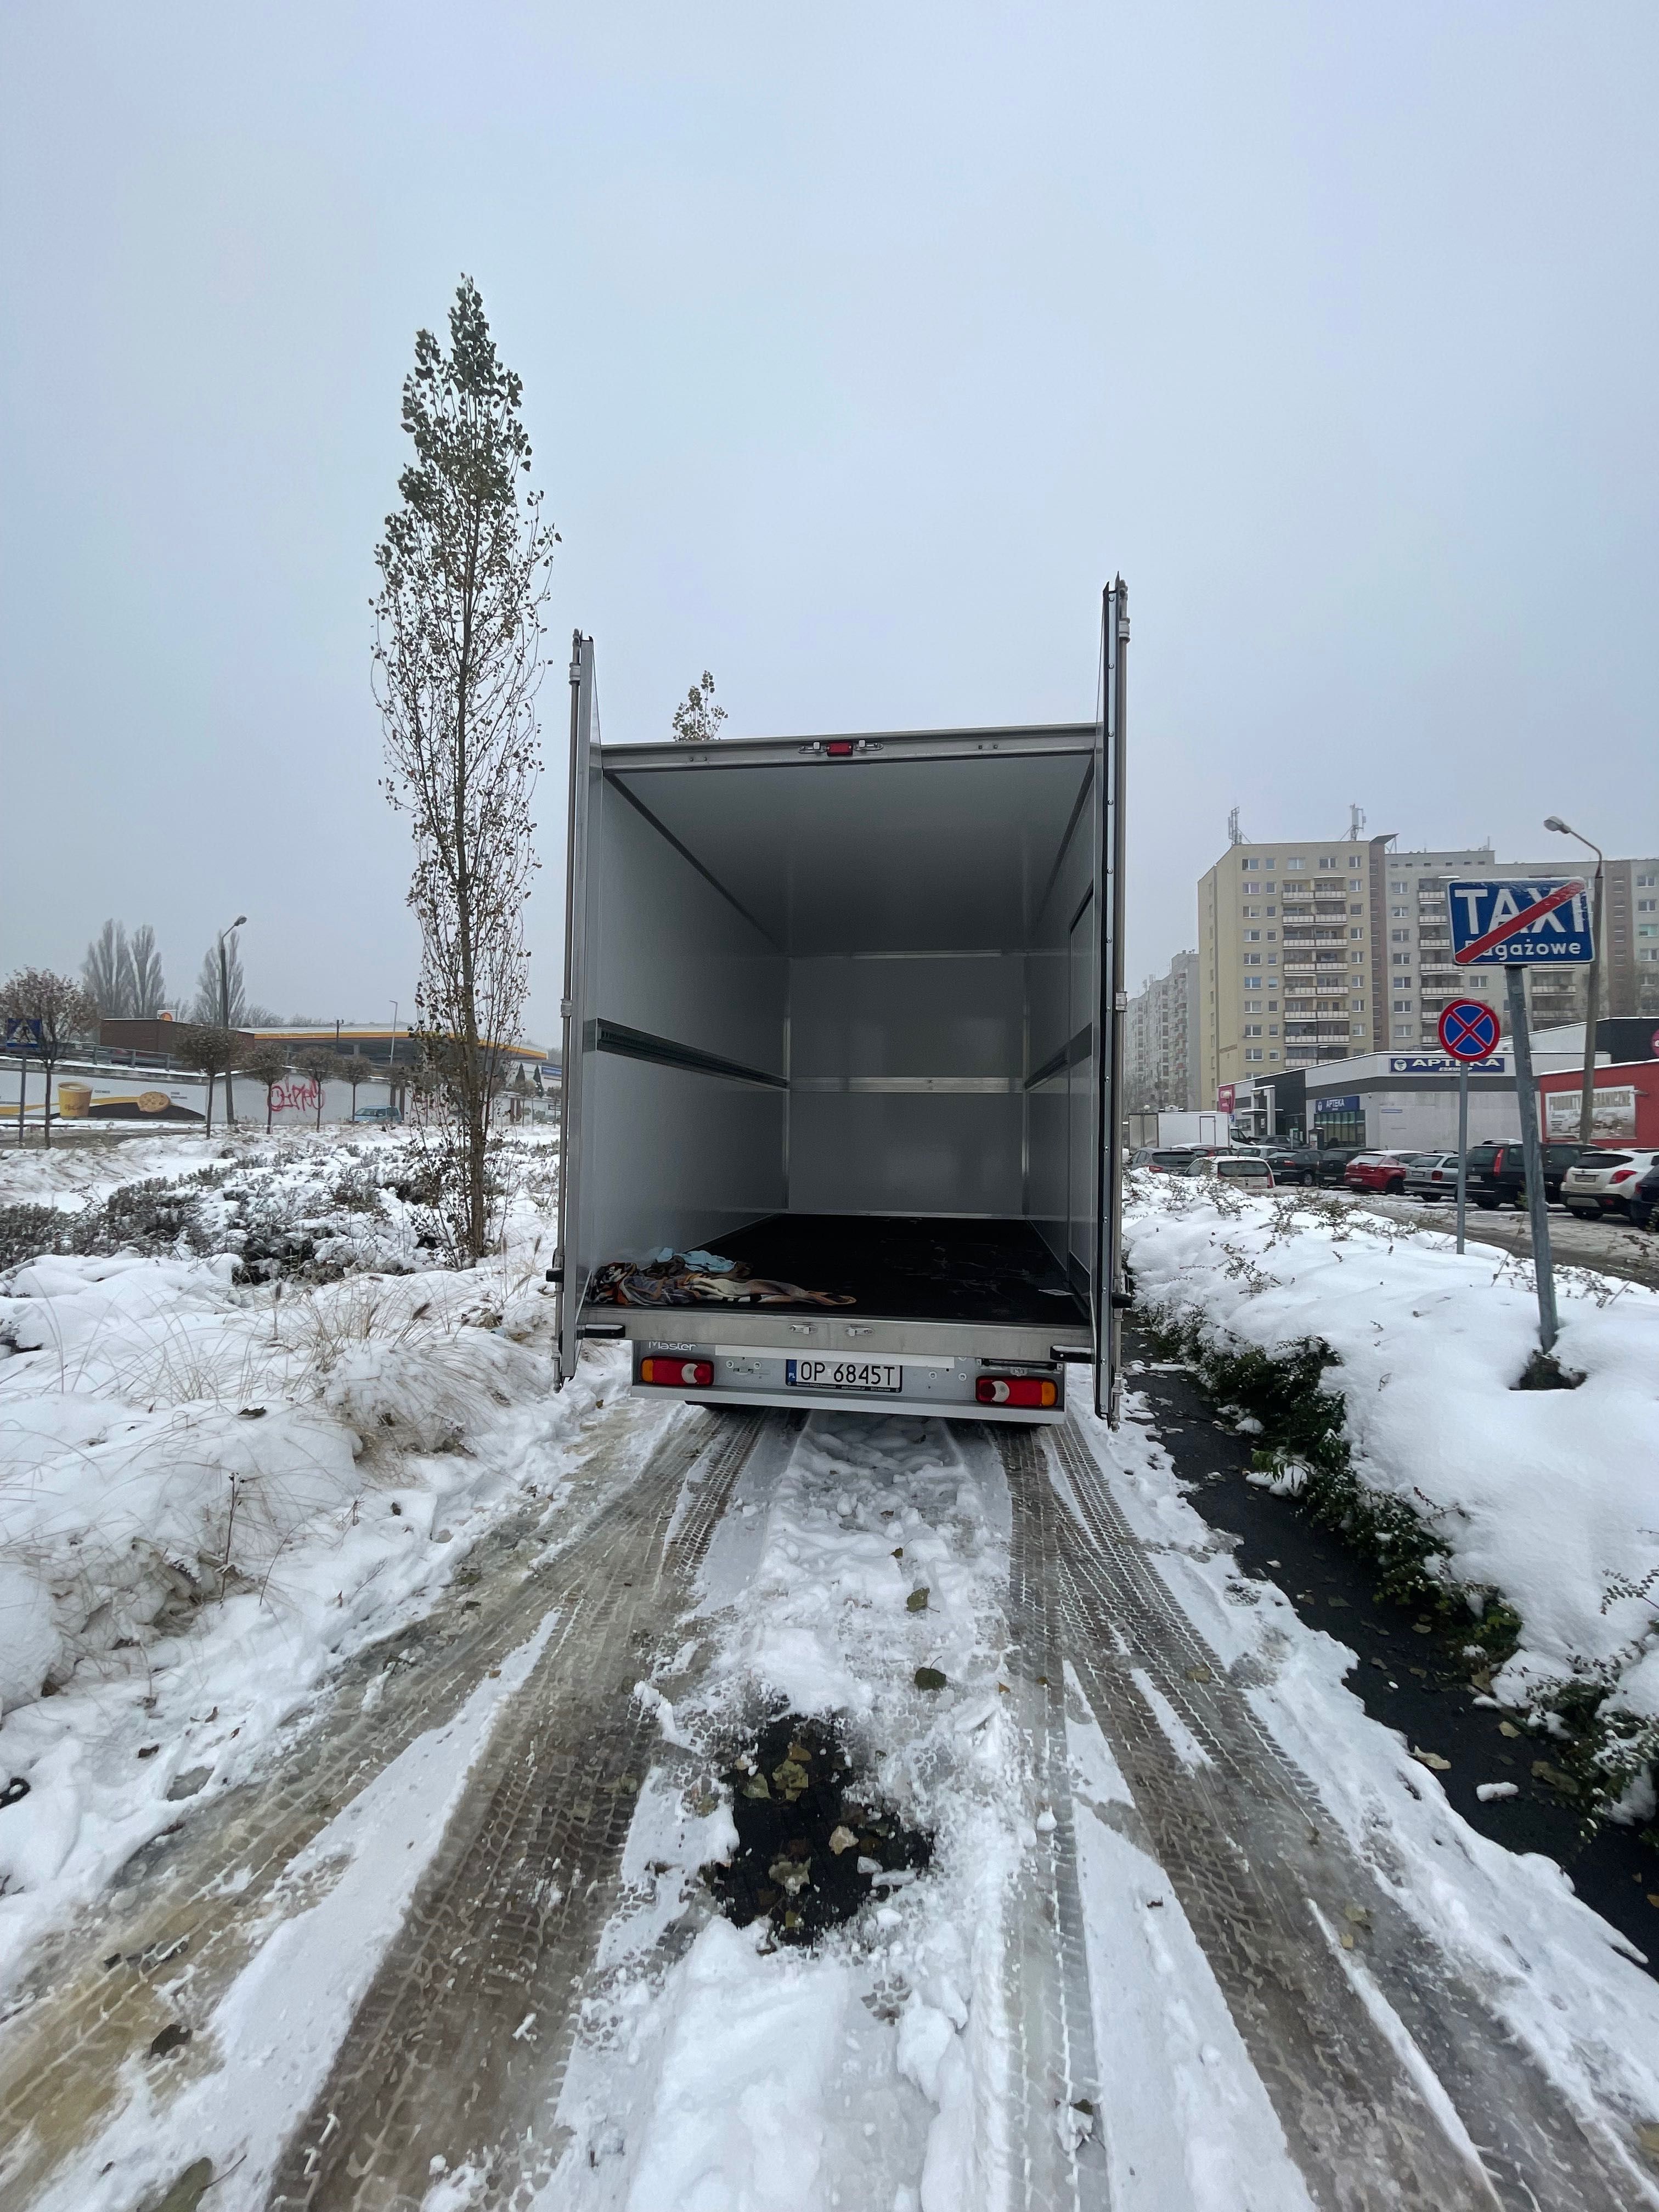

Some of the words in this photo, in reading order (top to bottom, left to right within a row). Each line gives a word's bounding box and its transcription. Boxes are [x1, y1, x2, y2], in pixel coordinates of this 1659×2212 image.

[1454, 887, 1585, 934] TAXI
[648, 1341, 697, 1351] Master
[801, 1362, 825, 1381] OP
[833, 1363, 895, 1386] 6845T
